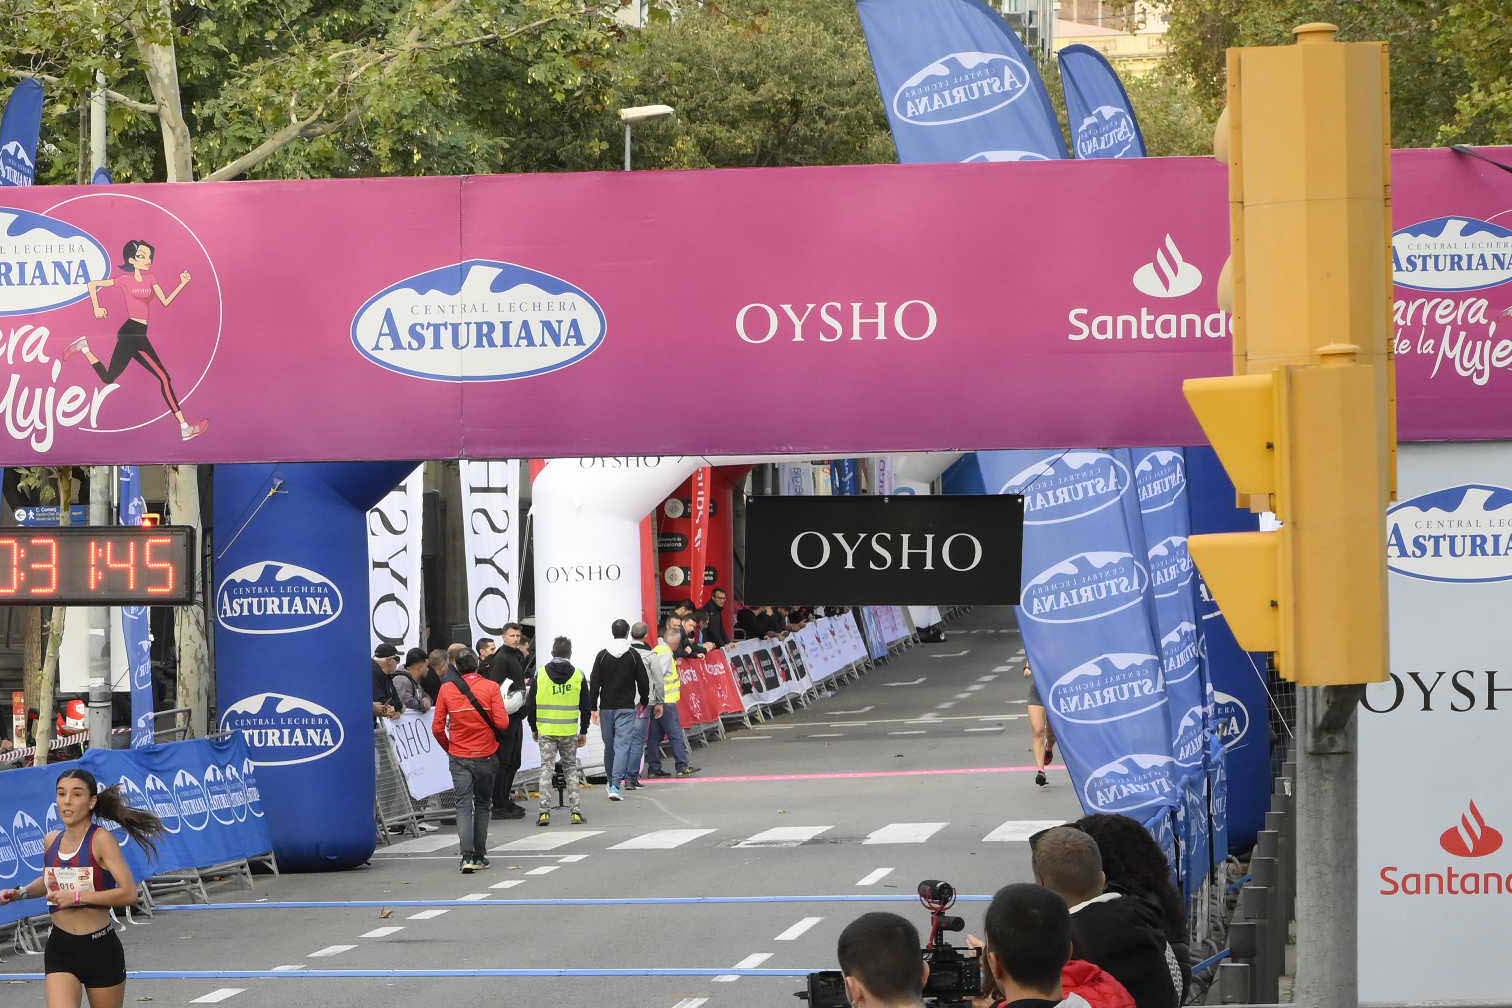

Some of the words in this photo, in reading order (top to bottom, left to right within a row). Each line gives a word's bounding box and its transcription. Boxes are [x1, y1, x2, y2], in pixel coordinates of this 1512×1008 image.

[1464, 241, 1512, 249] LECHER
[410, 302, 488, 316] CENTRAL
[497, 301, 577, 314] LECHERA
[735, 300, 937, 344] OYSHO
[1393, 298, 1488, 326] arrera
[371, 306, 587, 352] ASTURIANA
[1068, 307, 1234, 341] Santand
[1417, 327, 1435, 354] la
[1430, 321, 1512, 385] Muje
[1415, 519, 1480, 530] CENTRAL
[791, 530, 983, 571] OYSHO
[546, 564, 622, 583] OYSHO
[220, 588, 333, 618] ASTURIANA
[233, 586, 275, 595] CENTRAL
[280, 584, 328, 594] LECHERA
[552, 683, 572, 696] Life
[1361, 669, 1512, 713] OYSH
[234, 717, 276, 726] CENTRAL
[281, 716, 329, 725] LECHERA
